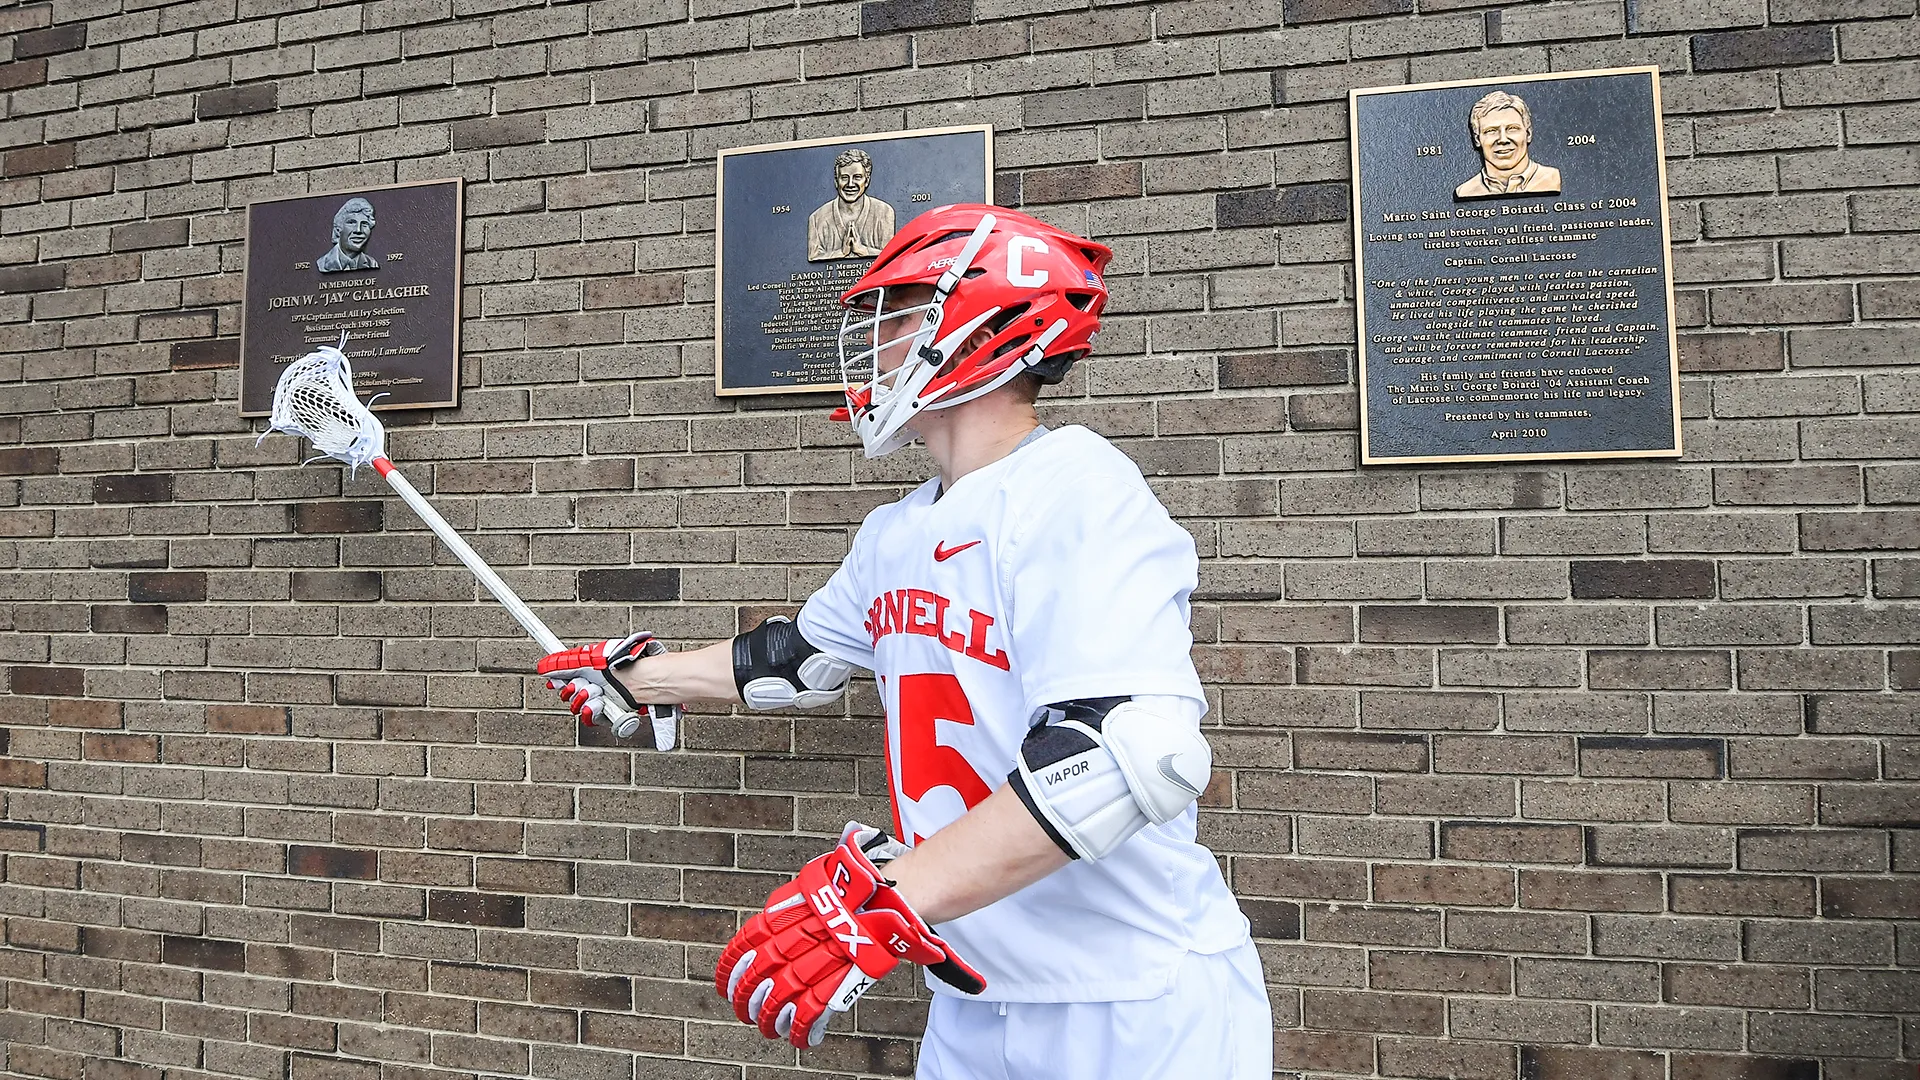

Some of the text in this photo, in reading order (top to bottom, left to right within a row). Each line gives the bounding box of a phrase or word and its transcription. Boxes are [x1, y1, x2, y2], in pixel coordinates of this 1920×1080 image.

[1566, 134, 1596, 145] 2004
[1416, 145, 1442, 156] 1981
[911, 193, 931, 202] 2001
[772, 204, 790, 213] 1954
[1383, 211, 1417, 222] Mario
[1421, 209, 1451, 220] Saint
[1455, 208, 1496, 220] George
[1553, 201, 1585, 212] Class
[1590, 199, 1604, 209] of
[1608, 197, 1637, 208] 2004
[1368, 233, 1403, 244] Loving
[1428, 229, 1446, 238] and
[1493, 224, 1518, 235] loyal
[1561, 220, 1615, 232] passionate
[1424, 239, 1460, 249] tireless
[1506, 234, 1544, 244] selfless
[1548, 232, 1597, 242] teammate
[386, 253, 403, 262] 1992
[1006, 235, 1049, 288] C
[1490, 253, 1528, 264] Cornell
[1531, 252, 1577, 261] Lacrosse
[836, 262, 863, 271] Memory
[318, 278, 377, 290] IN MEMORY OF
[790, 271, 824, 281] EAMON
[1400, 277, 1412, 288] of
[1414, 277, 1429, 286] the
[1432, 276, 1461, 287] finest
[1465, 275, 1495, 285] young
[1538, 272, 1561, 280] ever
[1564, 269, 1583, 278] don
[1587, 268, 1603, 277] the
[1607, 265, 1658, 276] carnelian
[747, 283, 760, 291] Led
[761, 281, 787, 290] Cornell
[798, 279, 820, 287] NCAA
[822, 278, 852, 286] Lacrosse
[1394, 289, 1403, 298] &
[1441, 286, 1477, 296] George
[1480, 283, 1515, 296] played
[1518, 282, 1541, 291] with
[1543, 280, 1586, 292] fearless
[268, 285, 430, 311] JOHN W. "JAY" GALLAGHER
[779, 293, 801, 301] NCAA
[803, 292, 832, 300] Division
[1389, 298, 1442, 309] unmatched
[1446, 296, 1525, 307] competitiveness
[1529, 293, 1549, 302] and
[1552, 290, 1602, 301] unrivaled
[372, 306, 406, 316] Selection
[1391, 299, 1638, 320] He lived his life playing the game he cherished
[1425, 319, 1474, 330] alongside
[1478, 318, 1494, 327] the
[1497, 317, 1551, 326] teammates
[1555, 314, 1567, 323] he
[1372, 334, 1408, 343] George
[1435, 331, 1451, 340] the
[1455, 330, 1496, 339] ultimate
[1554, 324, 1588, 337] friend
[1591, 323, 1611, 333] and
[1384, 344, 1403, 353] and
[1406, 343, 1426, 352] will
[1429, 342, 1442, 351] be
[1444, 341, 1482, 352] forever
[1486, 337, 1547, 349] remembered
[1549, 337, 1567, 348] for
[1570, 336, 1586, 345] his
[1439, 352, 1459, 362] and
[1462, 351, 1523, 361] commitment
[1541, 347, 1580, 358] Cornell
[1420, 365, 1613, 381] His family and friends have endowed
[1386, 384, 1405, 393] The
[1409, 382, 1439, 393] Mario
[1461, 381, 1498, 392] George
[1502, 378, 1540, 389] Boiardi
[1565, 377, 1613, 387] Assistant
[1617, 375, 1650, 385] Coach
[1392, 395, 1403, 404] of
[1406, 395, 1451, 404] Lacrosse
[1455, 394, 1465, 402] to
[1469, 392, 1539, 402] commemorate
[1543, 390, 1559, 399] his
[1563, 389, 1581, 398] life
[1586, 388, 1604, 397] and
[1444, 411, 1494, 421] Presented
[1497, 410, 1510, 421] by
[1514, 410, 1530, 419] his
[1490, 428, 1547, 440] April 2010
[864, 589, 1010, 672] RNELL
[1045, 760, 1090, 786] VAPOR
[810, 884, 874, 958] STX
[888, 933, 911, 953] 15
[842, 976, 870, 1005] STX
